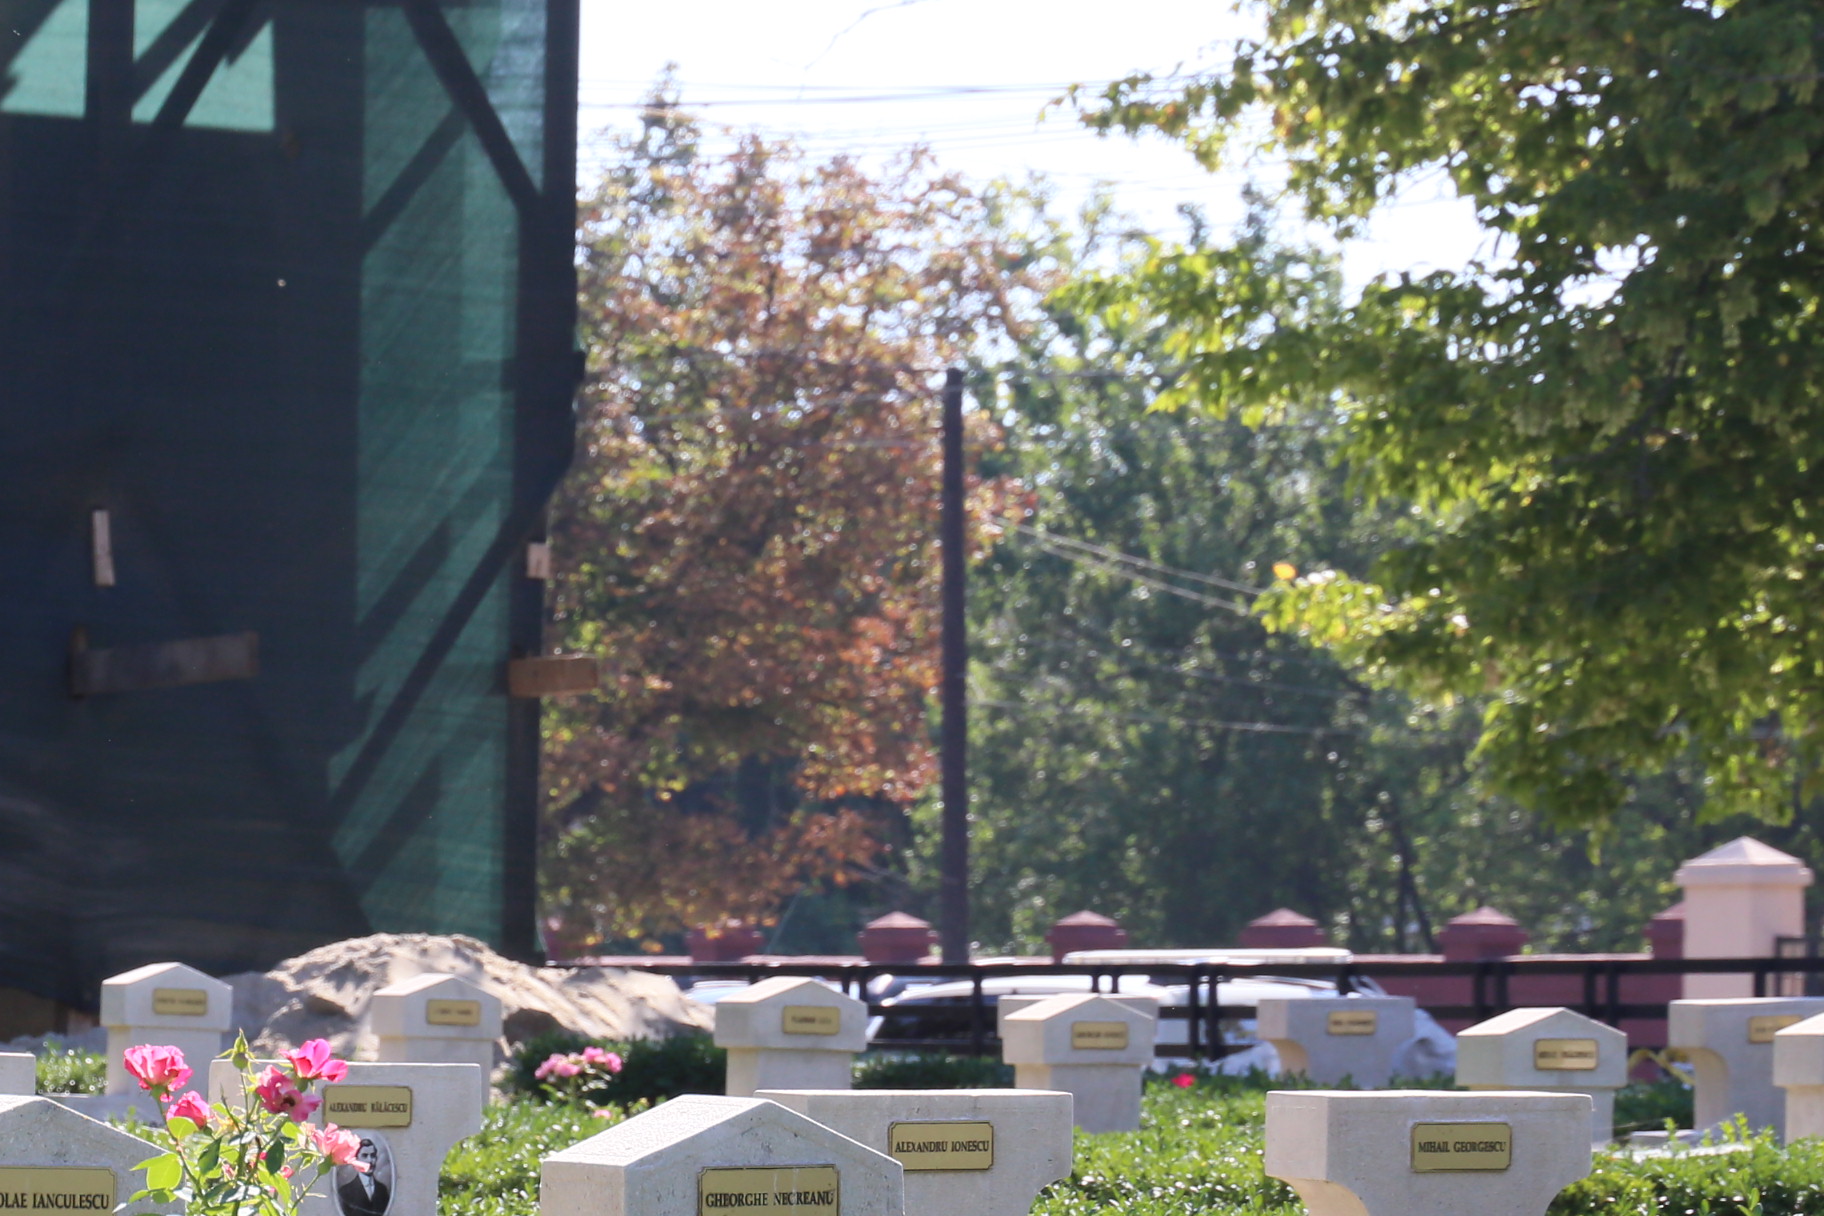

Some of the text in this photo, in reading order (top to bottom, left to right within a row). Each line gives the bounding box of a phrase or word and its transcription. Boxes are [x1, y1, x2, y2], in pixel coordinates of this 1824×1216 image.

[895, 1140, 990, 1153] ALEXANDRU IONESCU
[1418, 1141, 1507, 1153] MIHAIL GEORGESCU
[32, 1192, 110, 1210] IANCULESCU
[705, 1191, 769, 1208] GHEORGHE
